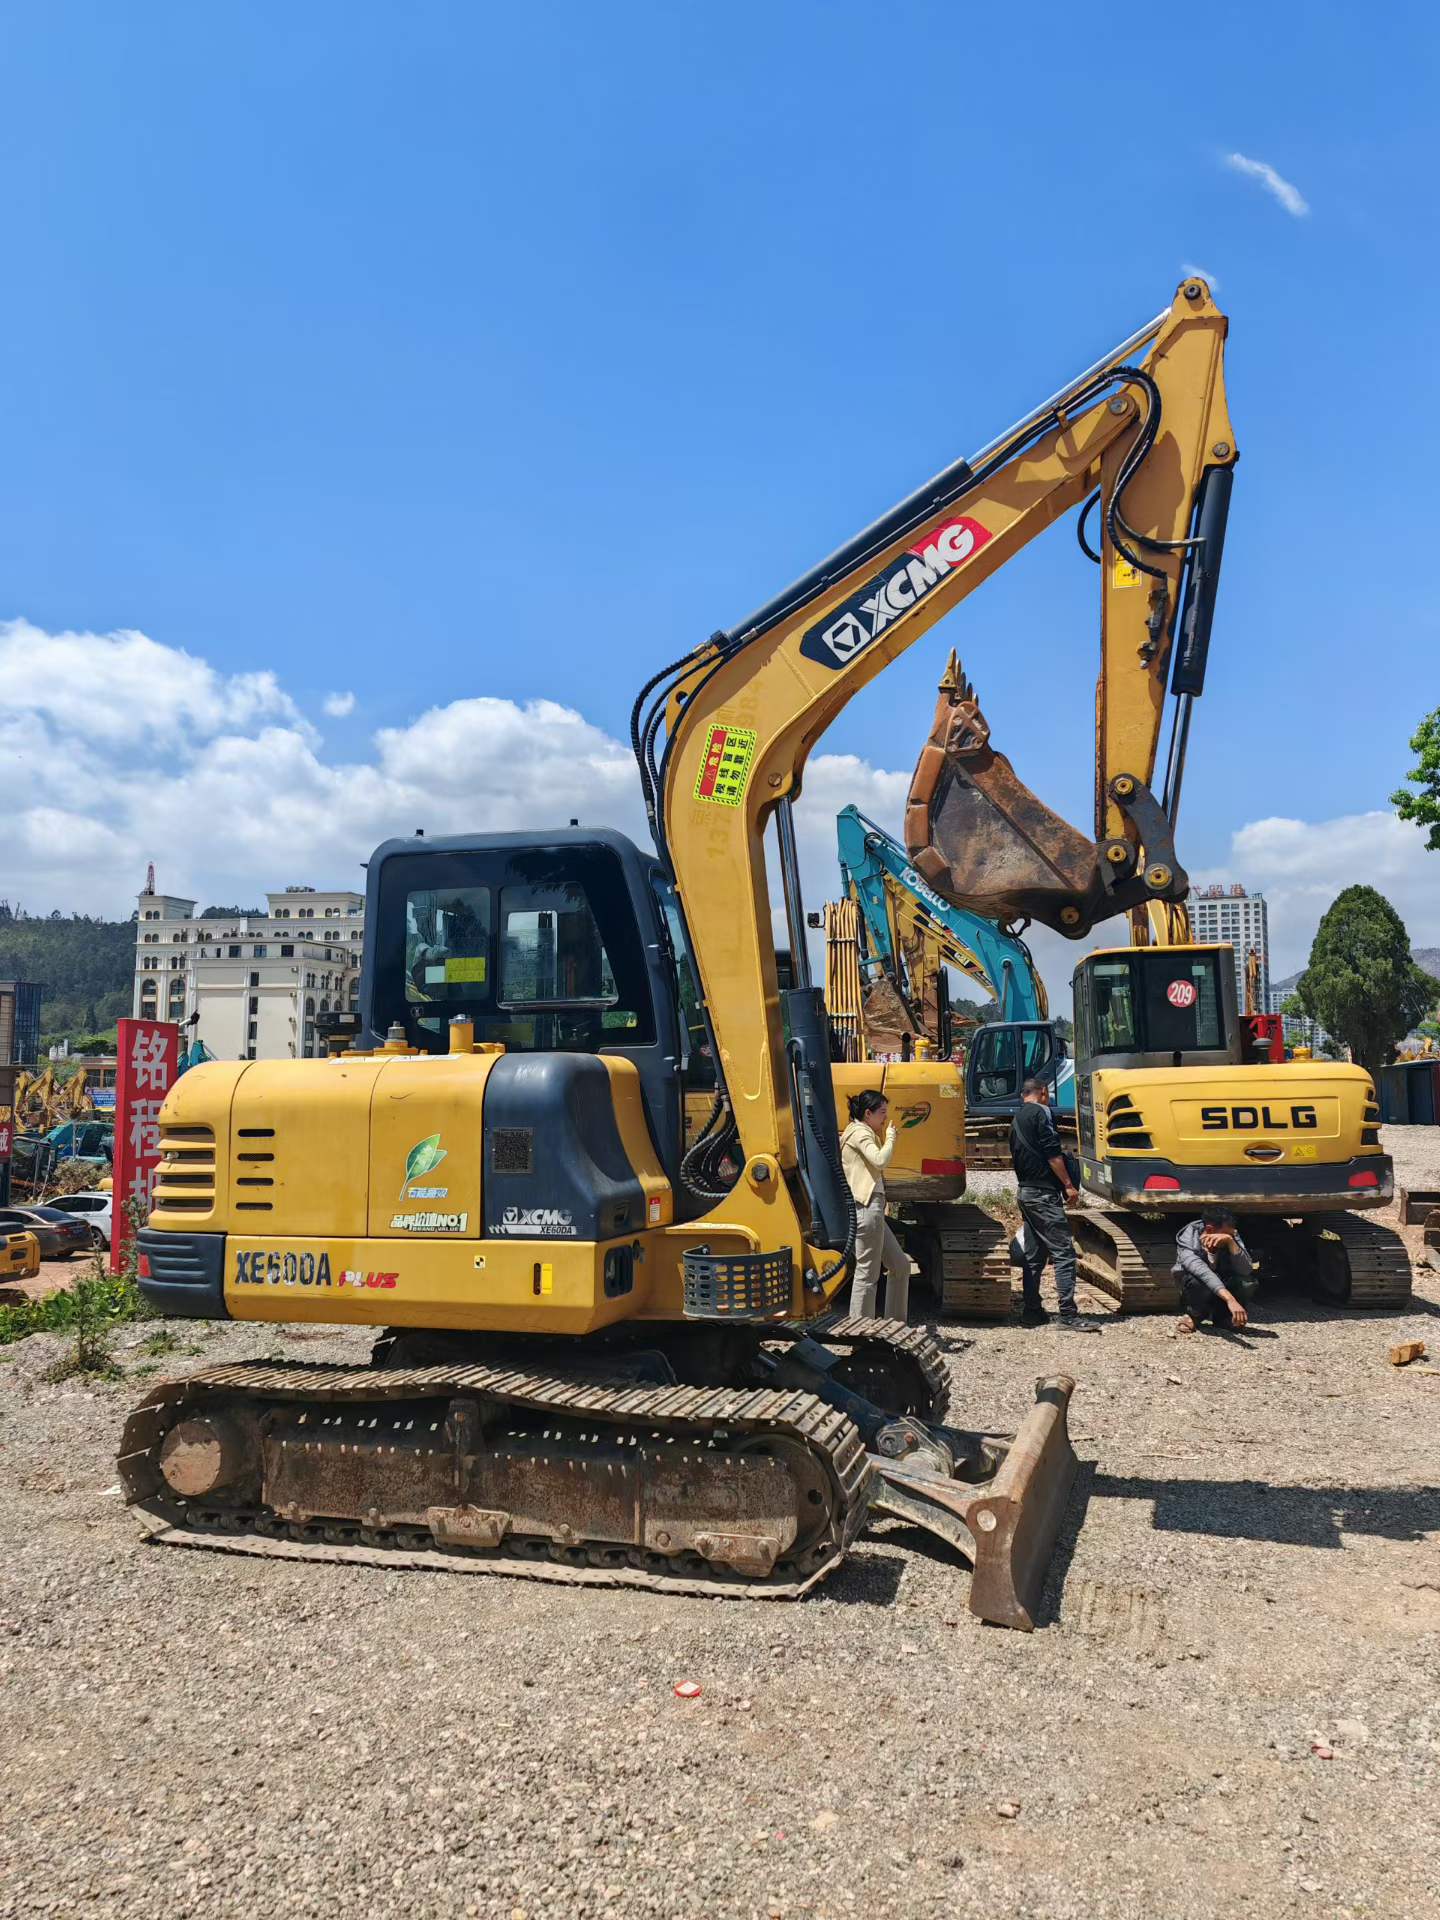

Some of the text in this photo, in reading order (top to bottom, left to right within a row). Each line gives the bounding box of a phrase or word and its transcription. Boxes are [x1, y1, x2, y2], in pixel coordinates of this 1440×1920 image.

[858, 524, 975, 637] XCMG
[708, 743, 722, 767] 危险
[715, 736, 736, 794] 视线盲区
[727, 738, 748, 796] 请勿靠近
[1169, 982, 1193, 1005] 209
[1201, 1105, 1318, 1130] SDLG
[517, 1208, 573, 1225] XCMG
[337, 1270, 400, 1289] PLUS
